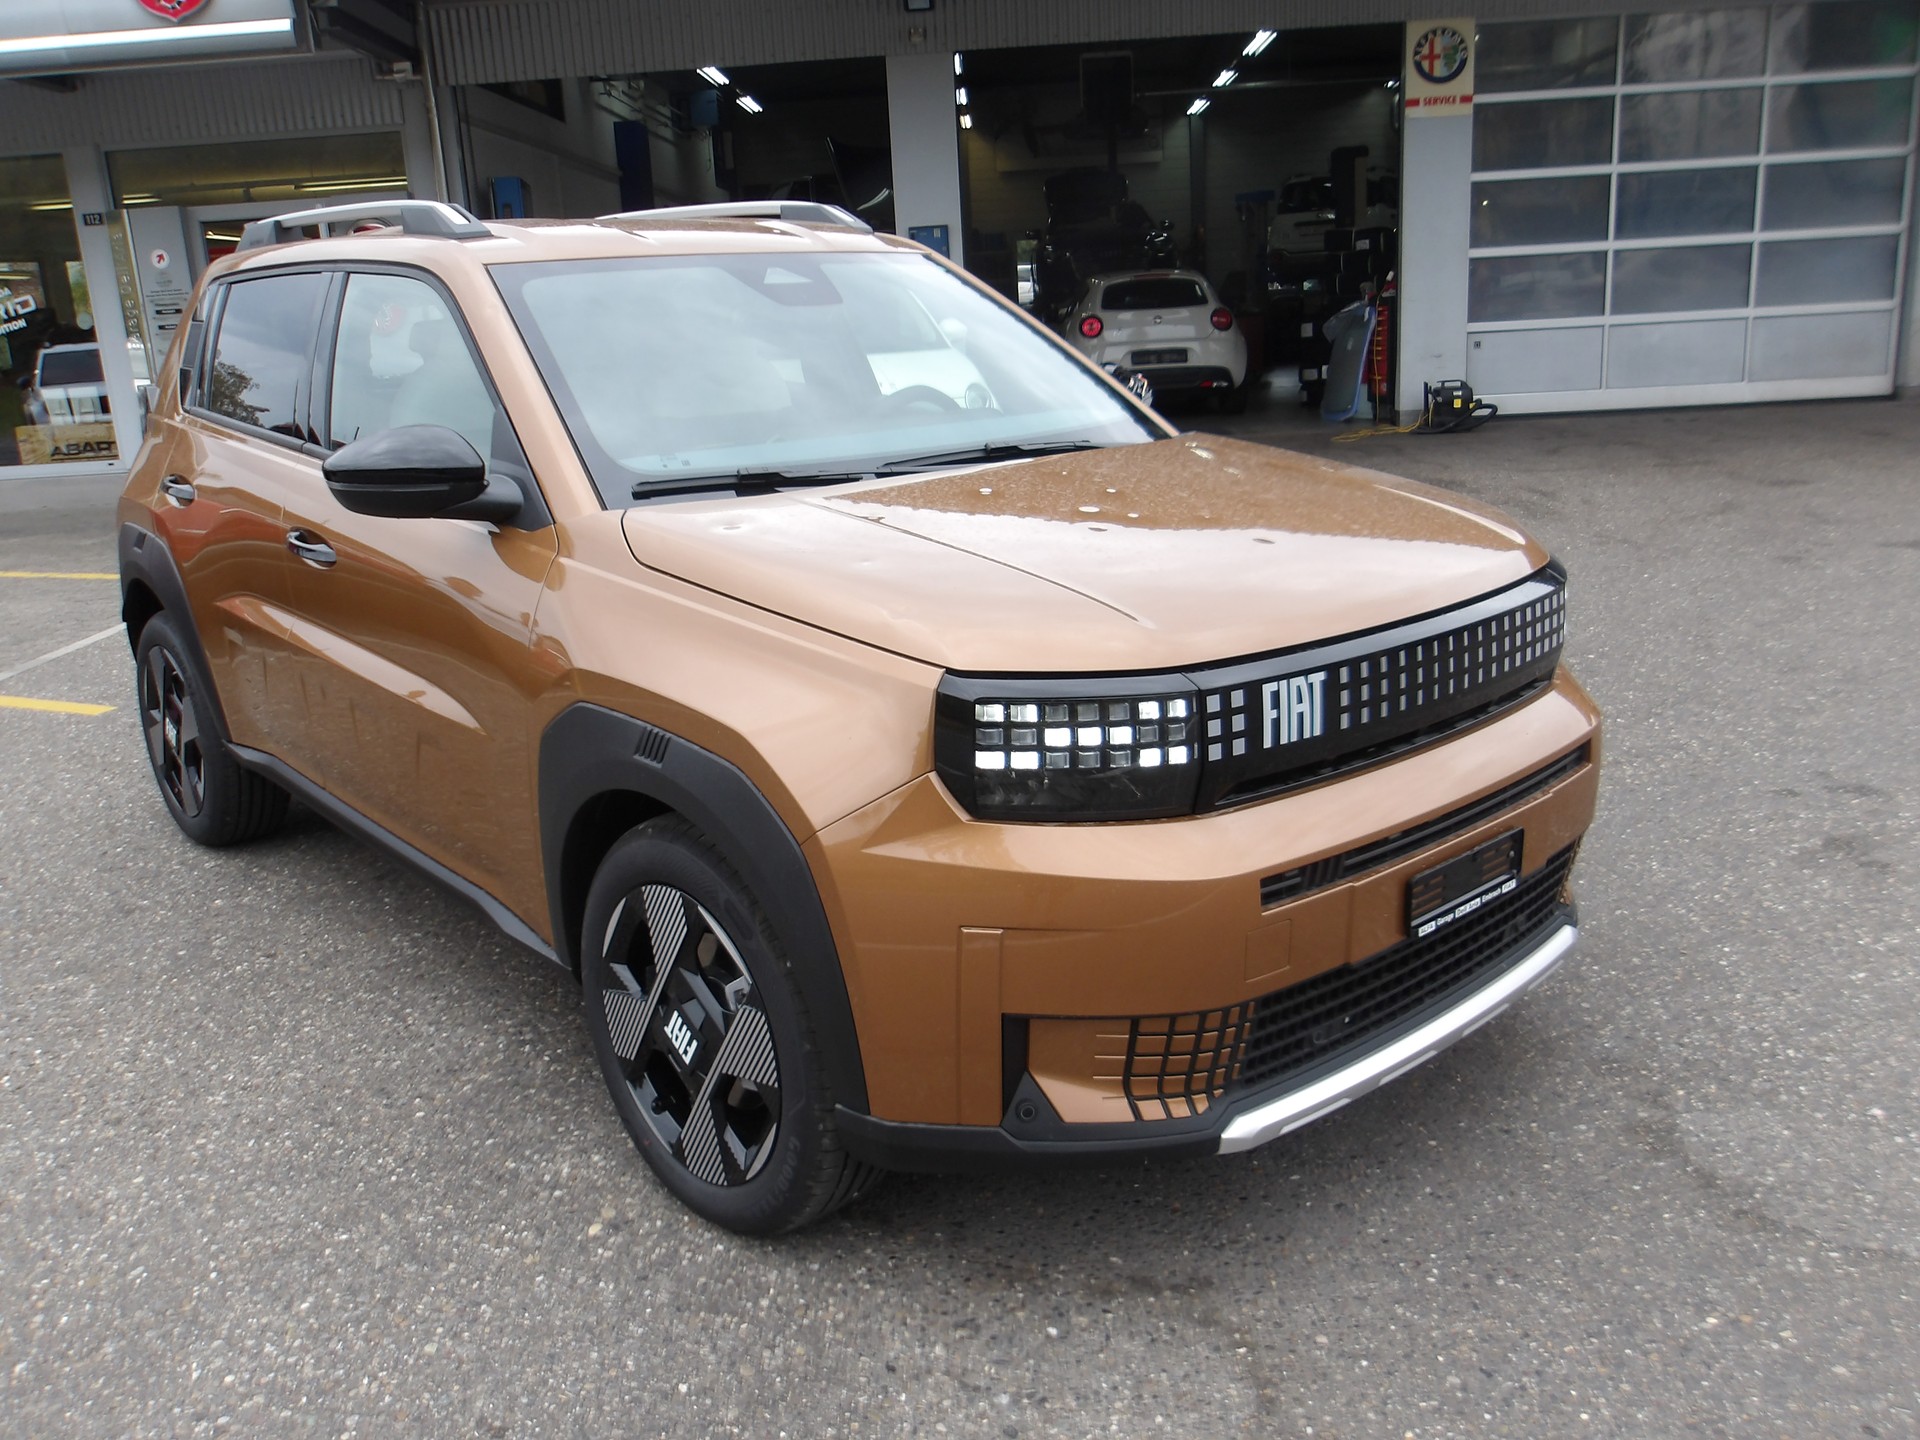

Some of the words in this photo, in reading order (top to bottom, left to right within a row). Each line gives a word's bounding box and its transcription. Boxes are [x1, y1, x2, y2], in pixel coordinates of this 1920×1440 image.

[1423, 95, 1457, 106] SERVICE
[85, 214, 100, 225] 112
[1262, 671, 1326, 749] FIAT
[664, 1009, 698, 1066] FIAT
